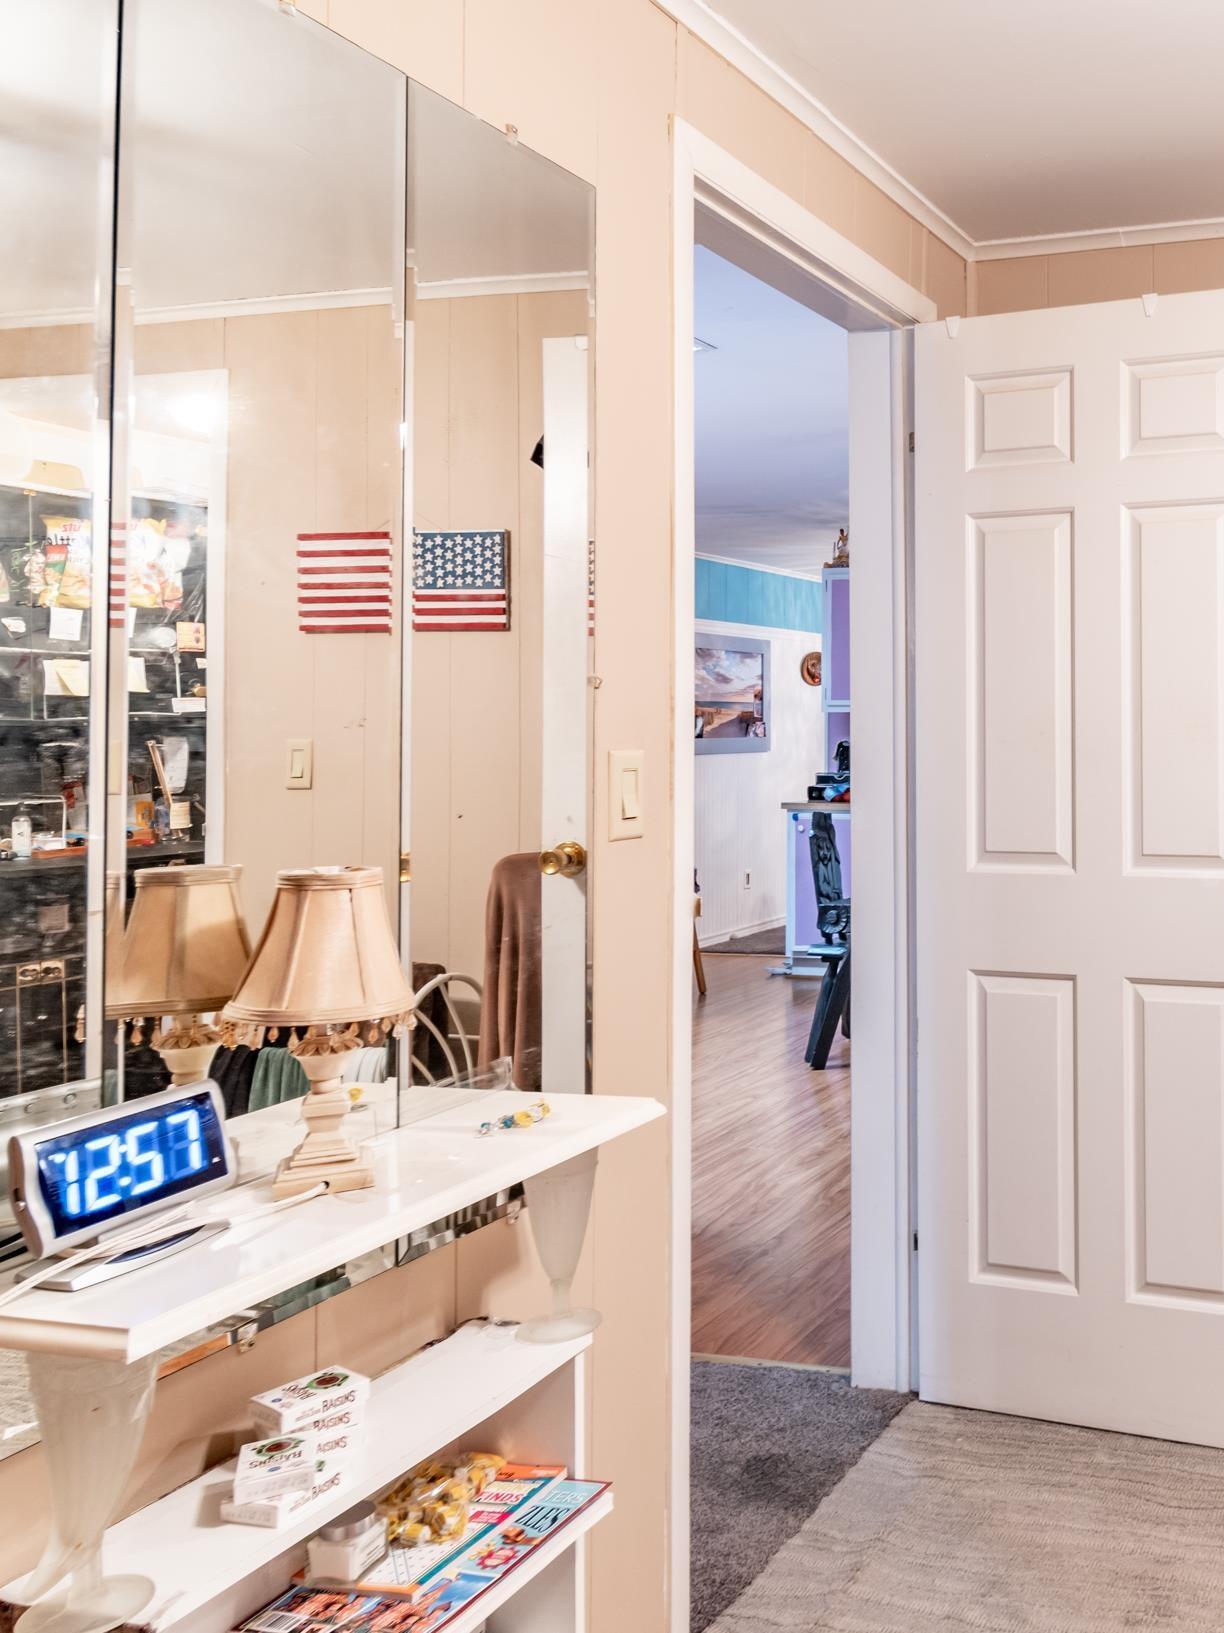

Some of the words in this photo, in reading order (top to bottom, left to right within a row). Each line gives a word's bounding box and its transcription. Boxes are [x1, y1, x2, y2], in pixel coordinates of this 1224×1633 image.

[63, 1109, 201, 1215] 12:57
[321, 1389, 357, 1412] RAISINS
[316, 1435, 348, 1454] AISINS
